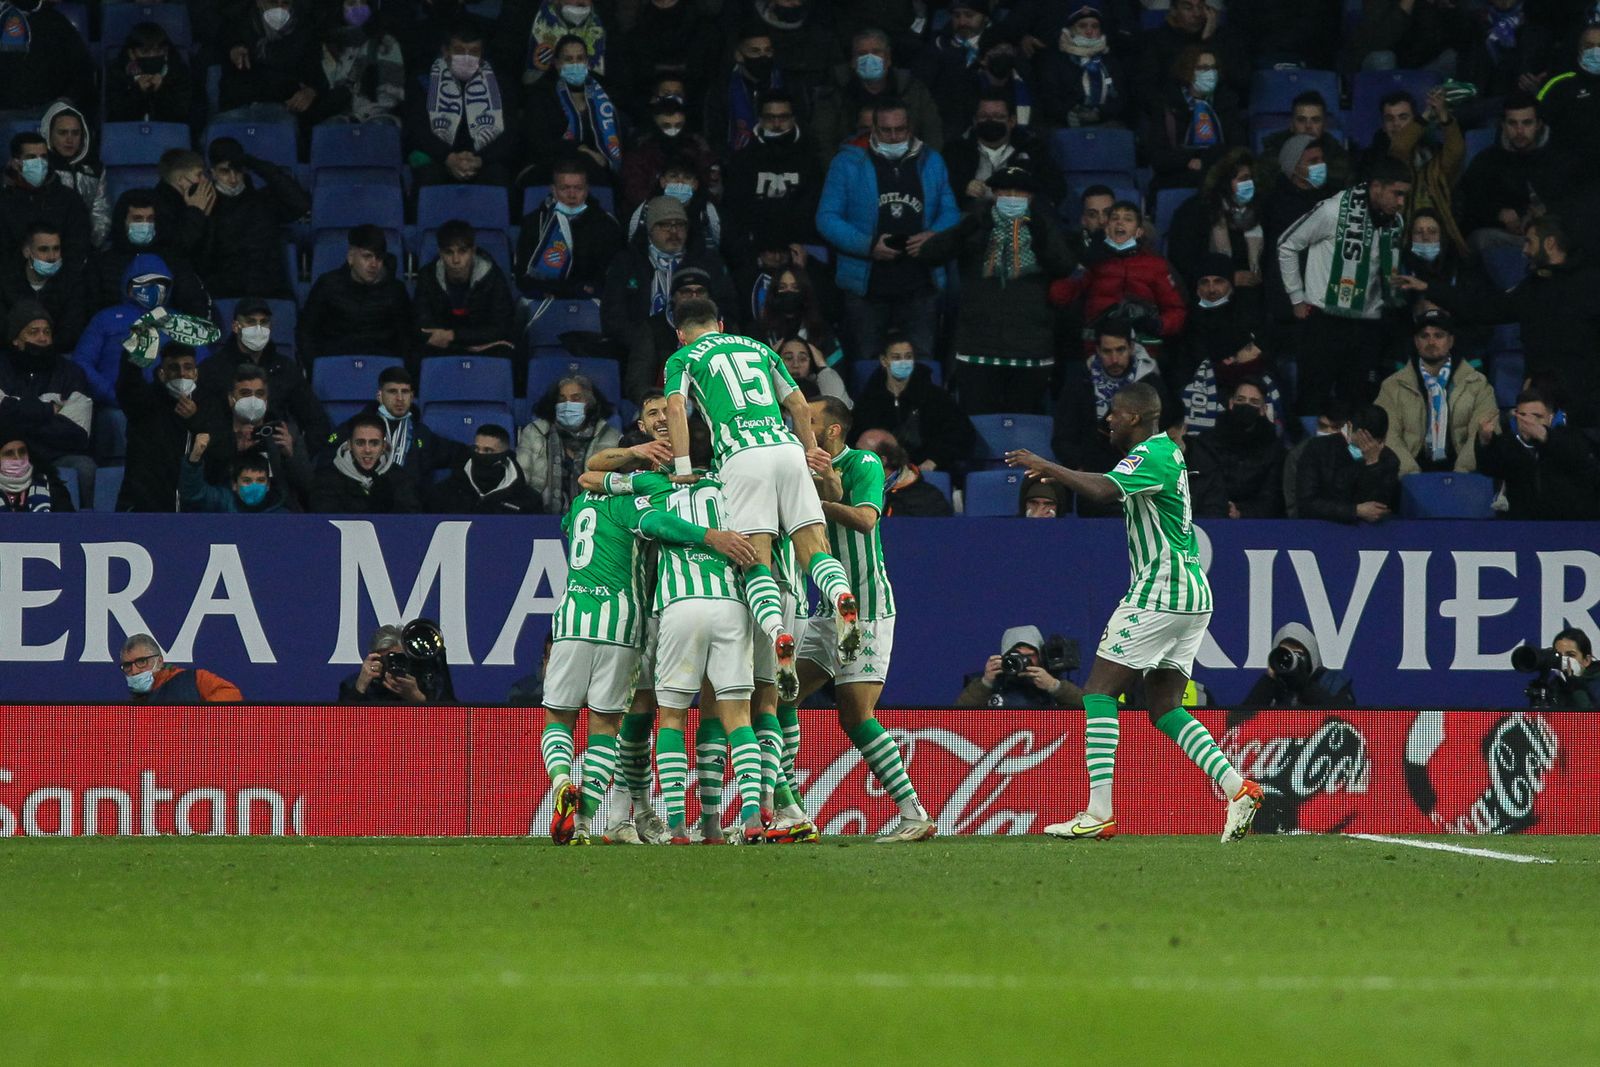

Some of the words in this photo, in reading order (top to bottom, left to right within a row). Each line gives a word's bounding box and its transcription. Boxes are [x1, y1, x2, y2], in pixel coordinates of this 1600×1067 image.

[879, 192, 923, 213] OTLAND
[687, 339, 715, 362] ALEX
[714, 335, 768, 357] MORENO
[708, 351, 774, 410] 15
[570, 507, 597, 571] 8
